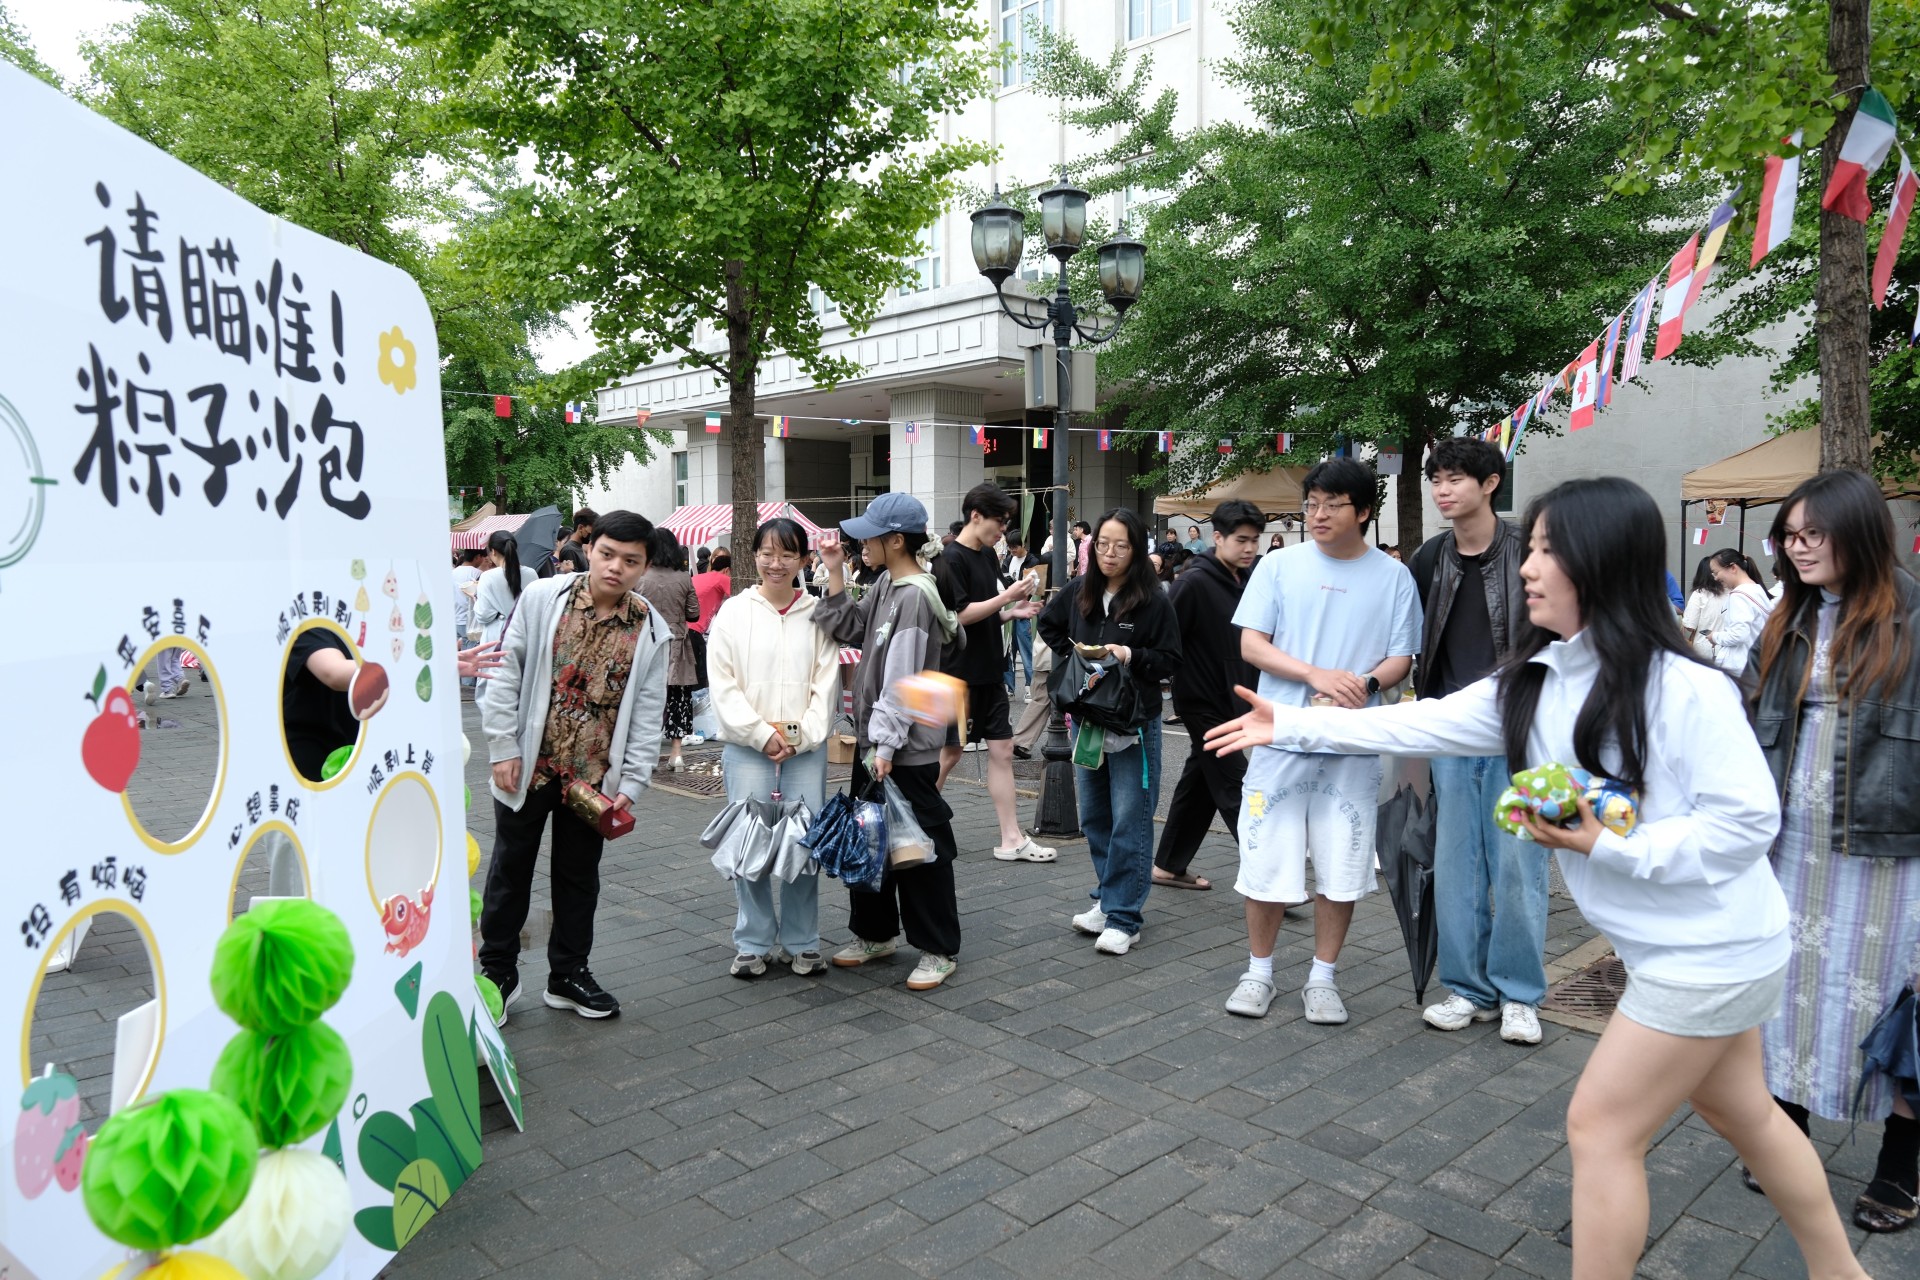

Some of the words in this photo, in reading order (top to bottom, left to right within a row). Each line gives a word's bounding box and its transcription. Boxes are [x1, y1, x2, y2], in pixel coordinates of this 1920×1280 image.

[84, 181, 346, 385] 请瞄准！
[74, 342, 372, 521] 粽子沙泡
[117, 598, 211, 669] 平安喜乐
[276, 591, 352, 645] 顺顺利利
[367, 743, 435, 795] 顺利上岸
[1295, 780, 1320, 796] ME
[228, 783, 300, 850] 心想事成
[21, 856, 148, 950] 没有烦恼
